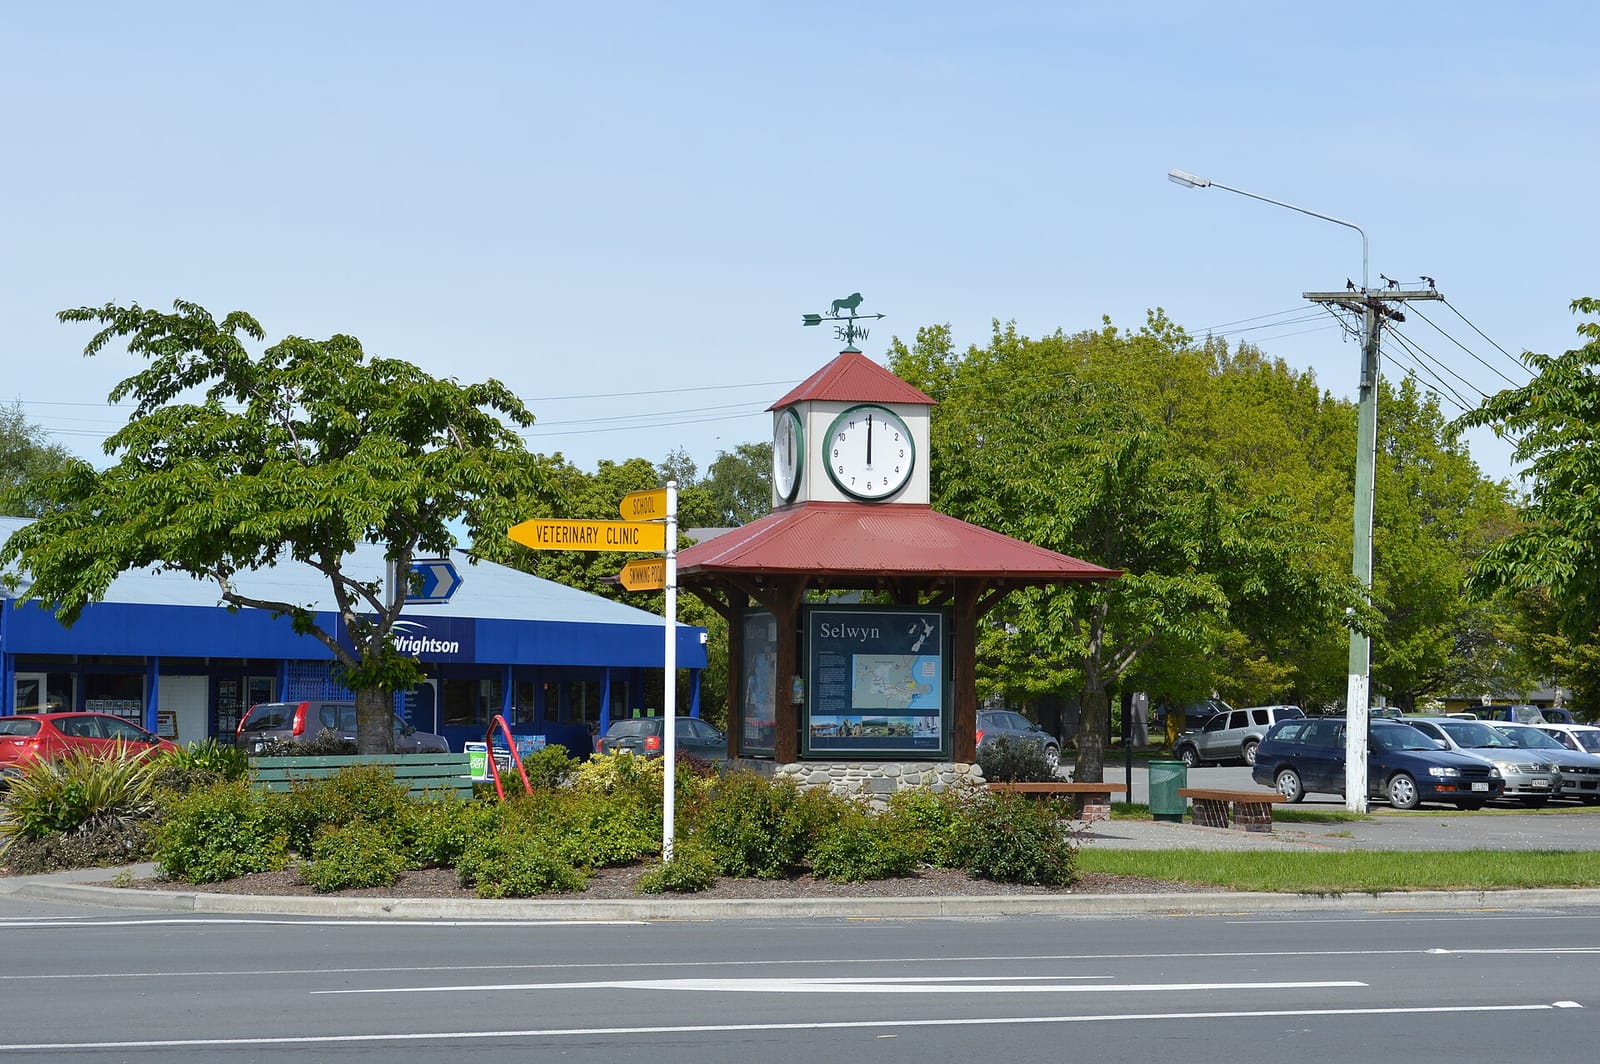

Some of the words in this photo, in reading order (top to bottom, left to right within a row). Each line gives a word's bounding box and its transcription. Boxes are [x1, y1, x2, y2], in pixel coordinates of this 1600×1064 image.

[849, 421, 855, 429] 11
[883, 422, 887, 430] 1
[838, 433, 846, 442] 10
[894, 433, 899, 441] 2
[834, 449, 839, 458] 9
[899, 449, 904, 458] 3
[839, 466, 844, 474] 8
[894, 465, 899, 473] 4
[851, 477, 855, 485] 7
[883, 477, 888, 485] 5
[867, 482, 872, 490] 6
[633, 497, 655, 515] SCHOOL
[536, 525, 599, 544] VETERINARY
[607, 527, 639, 545] CLINIC
[820, 623, 880, 642] Selwyn
[392, 635, 459, 655] Wrightson
